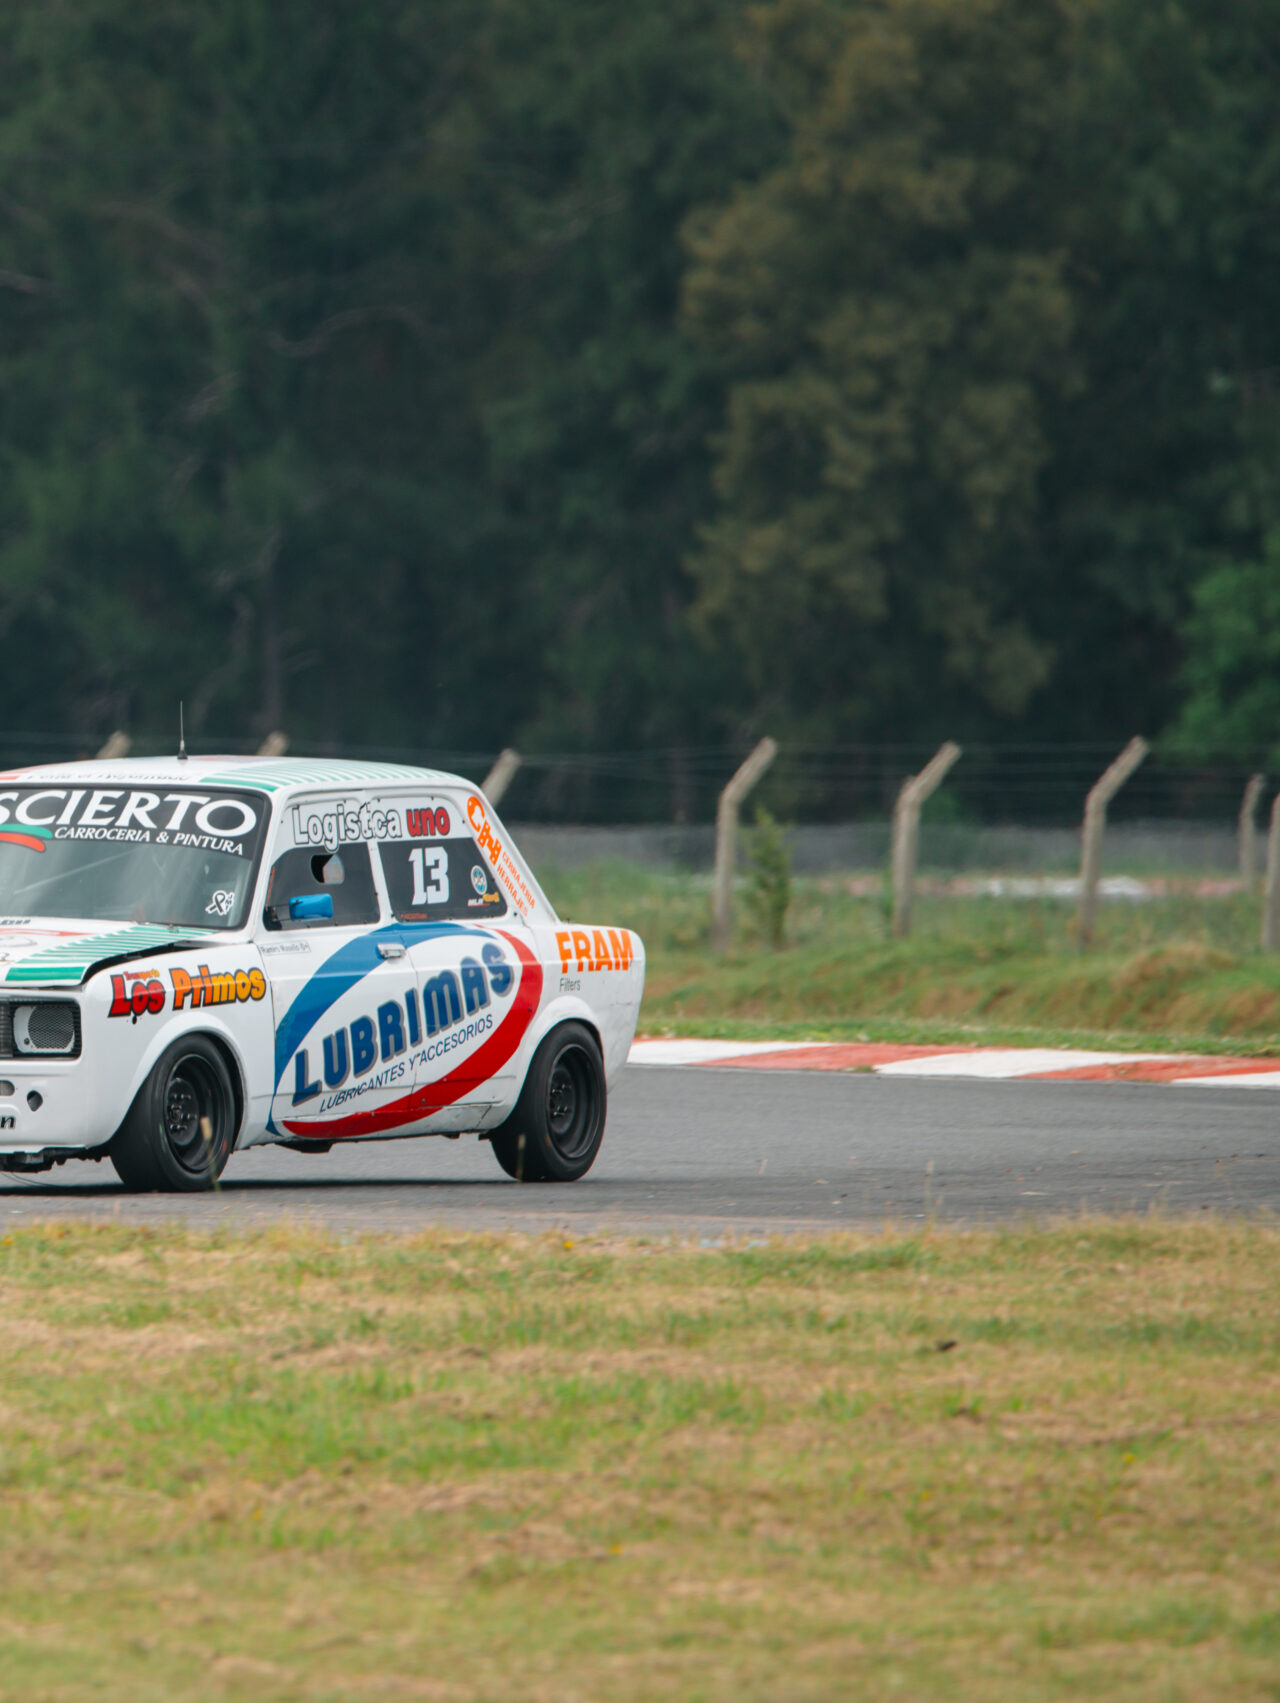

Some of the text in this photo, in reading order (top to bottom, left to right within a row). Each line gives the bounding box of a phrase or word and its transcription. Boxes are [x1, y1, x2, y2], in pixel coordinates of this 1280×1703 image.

[54, 827, 244, 856] CARROCERIA & PINTURA
[406, 807, 450, 837] uno
[408, 847, 449, 905] 13
[555, 928, 634, 974] FRAM
[107, 964, 266, 1018] Los Primos
[292, 942, 515, 1106] LUBRIMAS
[320, 1013, 494, 1113] LUBRICANTES Y ACCESORIOS
